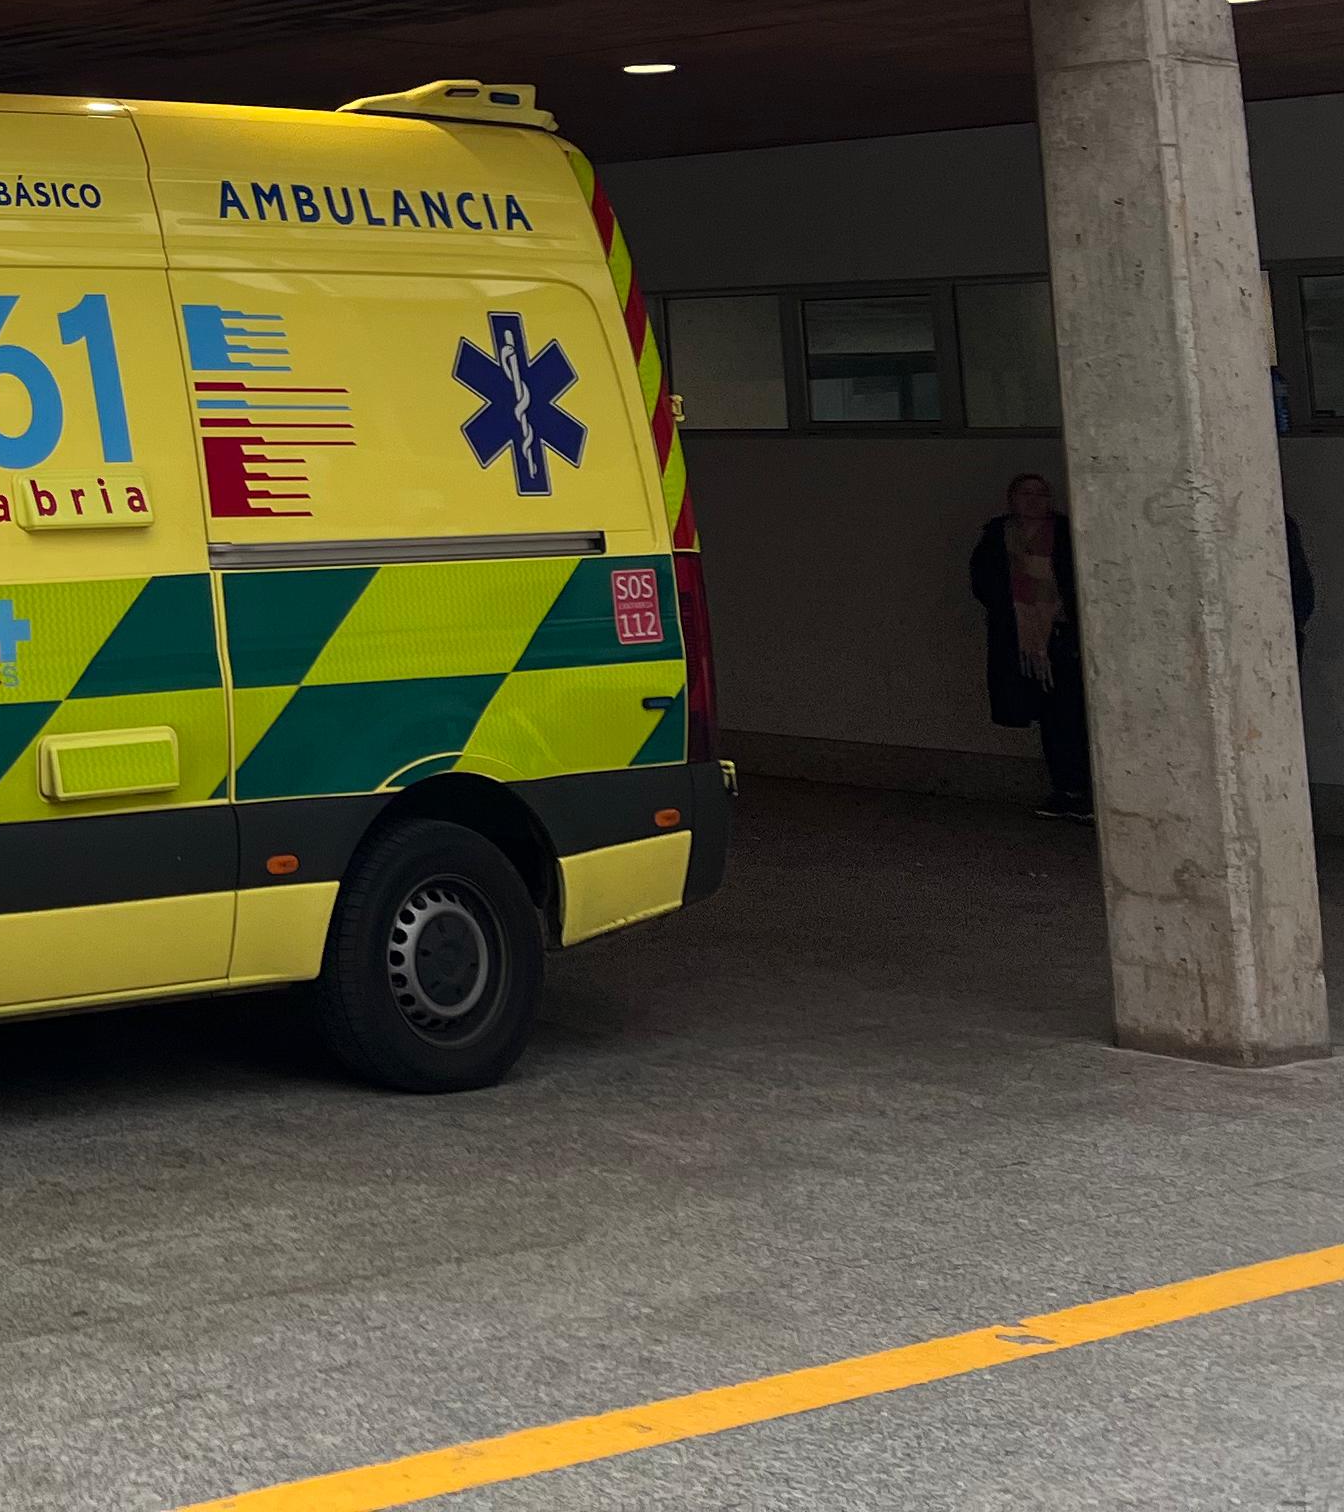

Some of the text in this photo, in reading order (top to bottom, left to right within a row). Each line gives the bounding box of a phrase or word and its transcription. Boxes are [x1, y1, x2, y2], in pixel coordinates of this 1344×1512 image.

[219, 180, 533, 231] AMBULANCIA
[616, 575, 653, 600] SOS
[619, 612, 658, 638] 112
